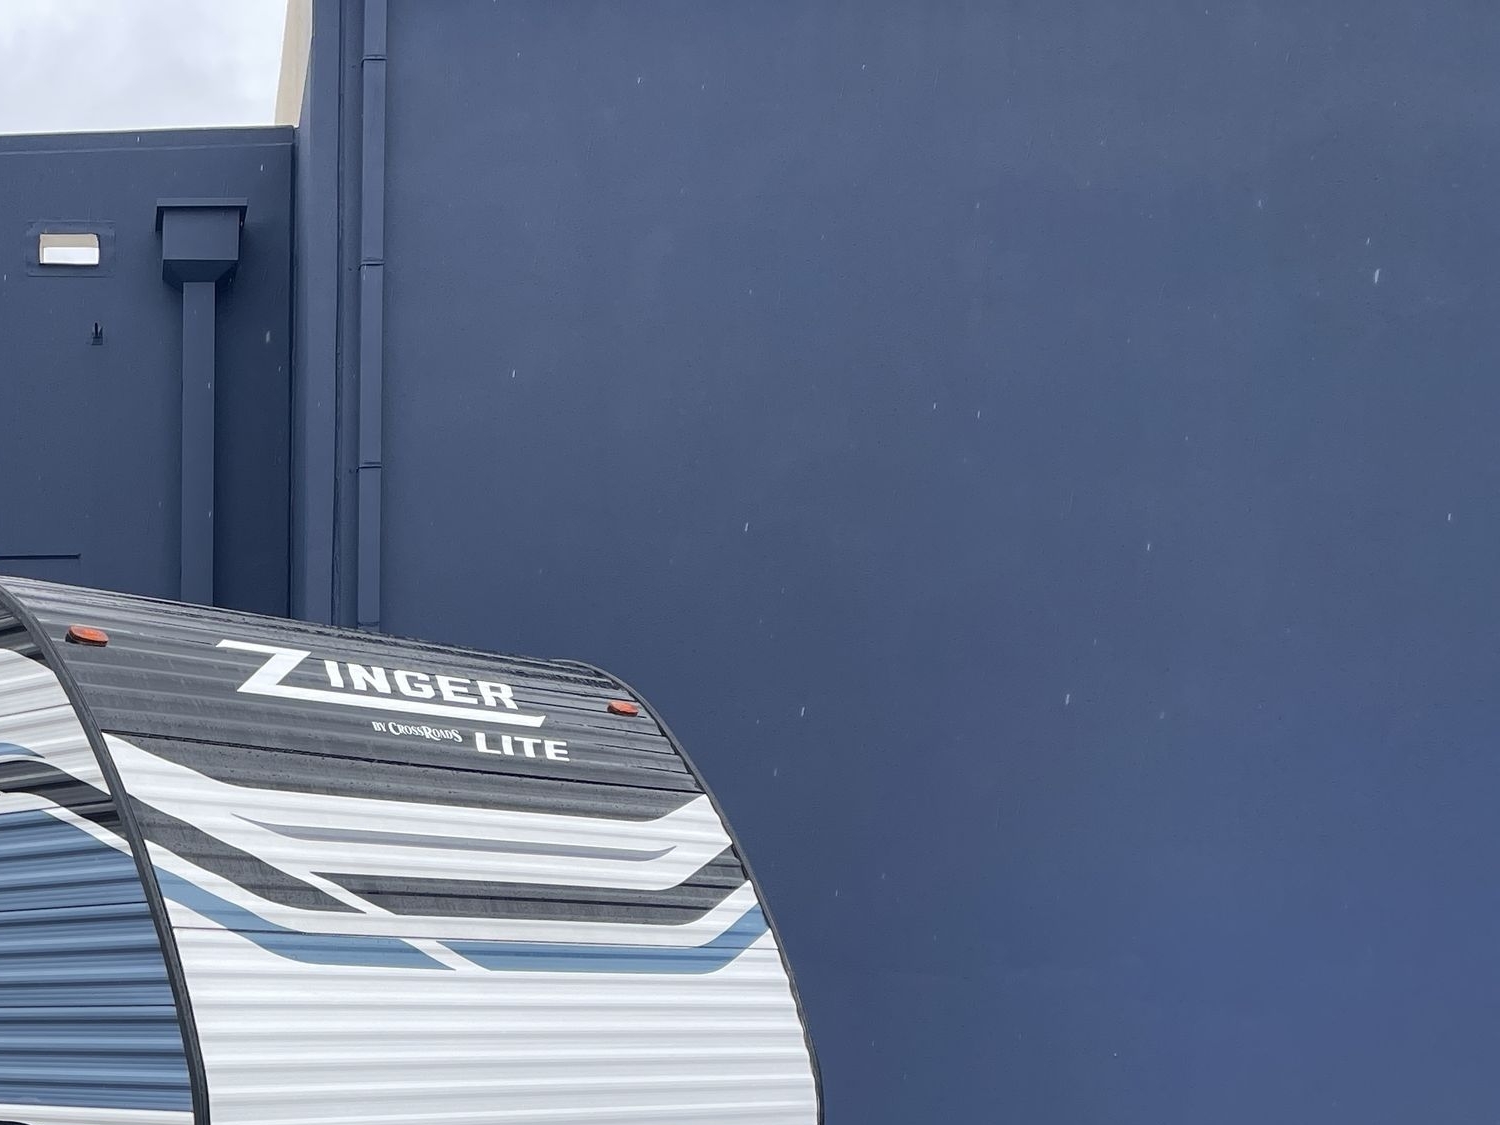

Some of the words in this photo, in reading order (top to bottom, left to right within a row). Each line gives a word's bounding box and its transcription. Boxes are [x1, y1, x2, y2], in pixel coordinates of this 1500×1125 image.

[215, 638, 546, 728] ZINGER
[371, 721, 387, 732] BY
[475, 731, 571, 762] LITE
